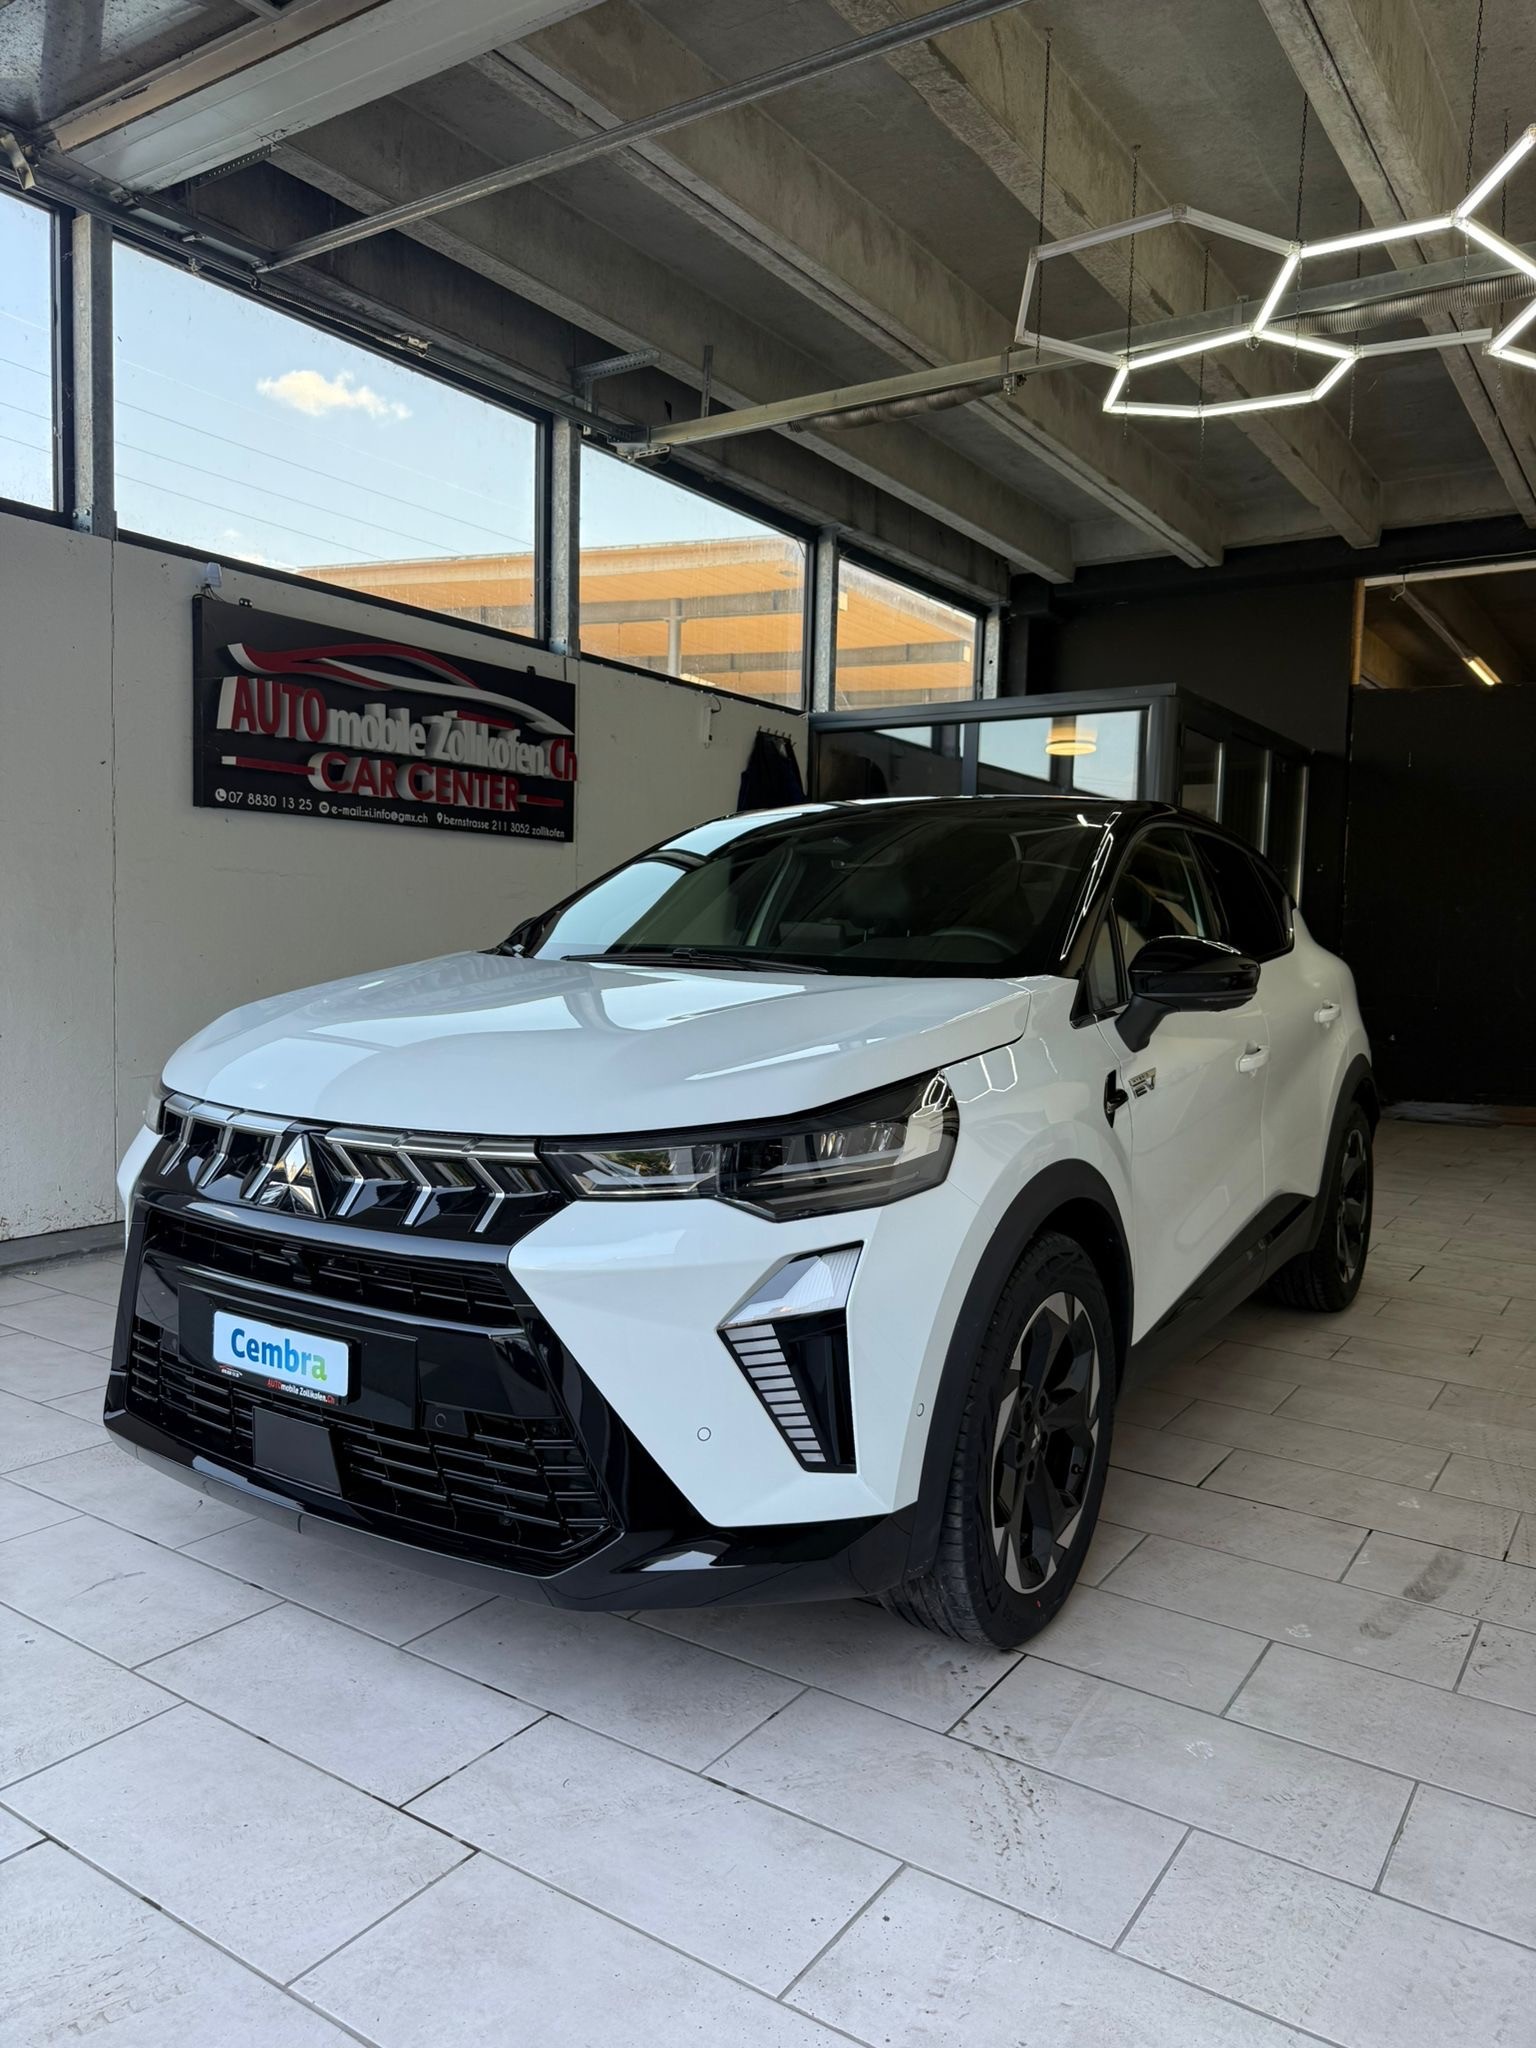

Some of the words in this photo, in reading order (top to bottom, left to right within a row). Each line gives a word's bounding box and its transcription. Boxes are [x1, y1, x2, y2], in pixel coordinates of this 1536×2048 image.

[217, 676, 427, 757] AUTOmobile
[308, 751, 399, 798] CAR
[399, 762, 520, 812] CENTER
[228, 791, 244, 804] 07
[247, 793, 277, 808] 8830
[282, 796, 295, 809] 13
[298, 798, 313, 811] 25
[443, 813, 490, 830] bernstrasse
[492, 819, 507, 832] 211
[510, 821, 530, 835] 3052
[531, 826, 565, 838] zollikofen
[231, 1328, 328, 1382] Cembra
[266, 1378, 299, 1395] AUTOmobile
